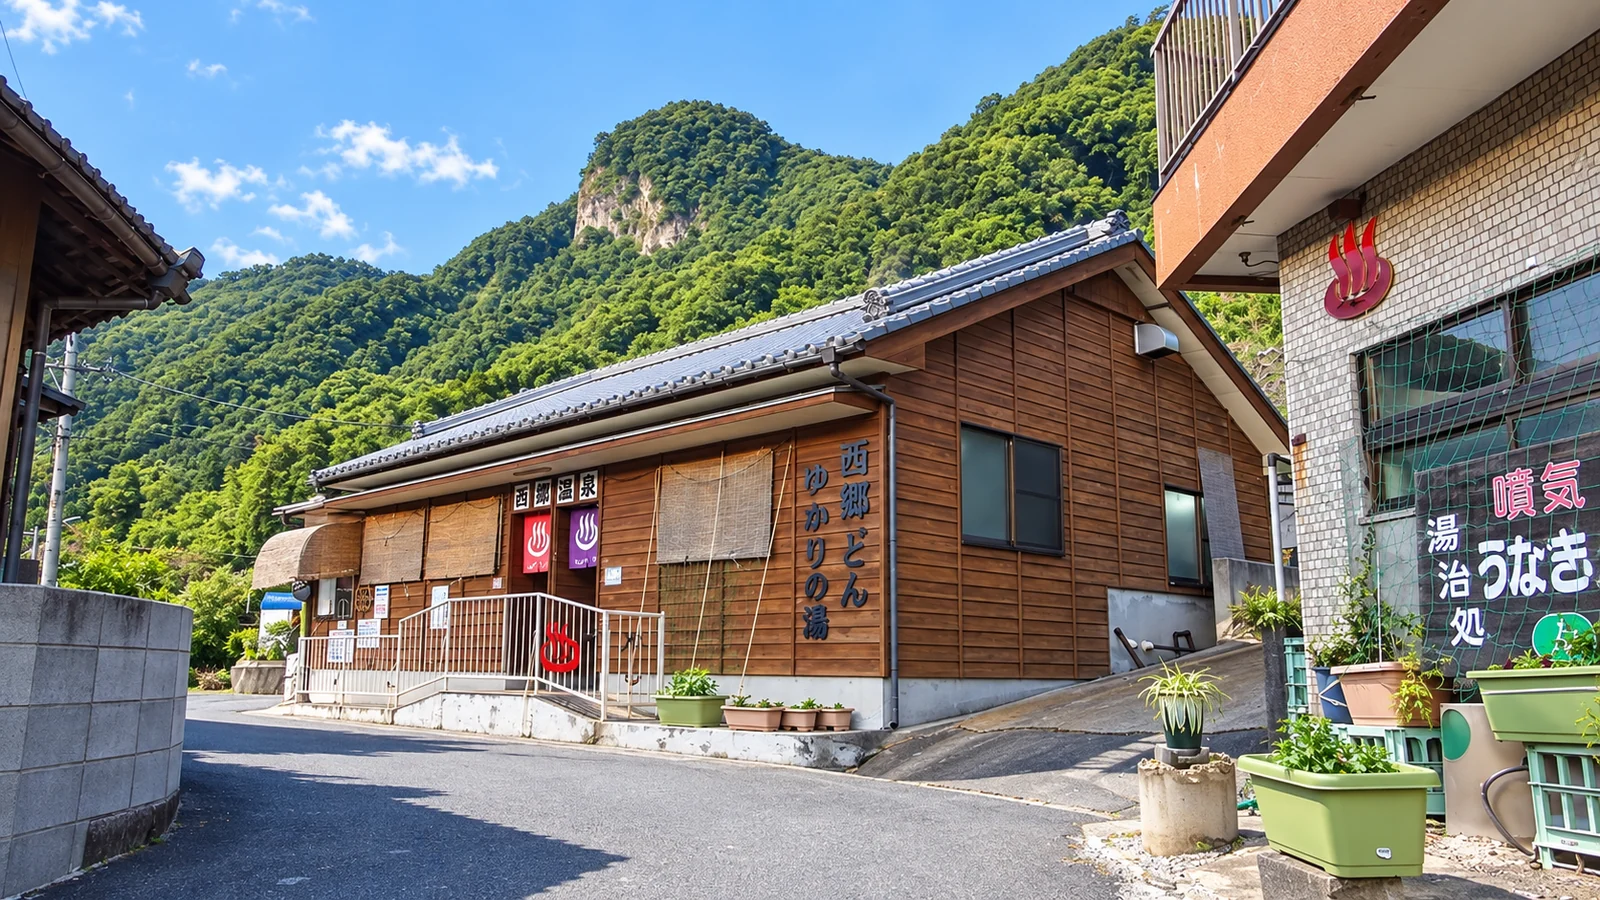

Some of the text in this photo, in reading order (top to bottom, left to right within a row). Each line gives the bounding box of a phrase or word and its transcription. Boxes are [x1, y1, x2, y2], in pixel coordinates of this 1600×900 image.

[515, 473, 596, 508] 西郷温泉
[803, 464, 829, 640] ゆかりの湯
[840, 439, 869, 608] 西郷どん
[1492, 460, 1586, 520] 噴気
[1426, 514, 1486, 646] 湯治処
